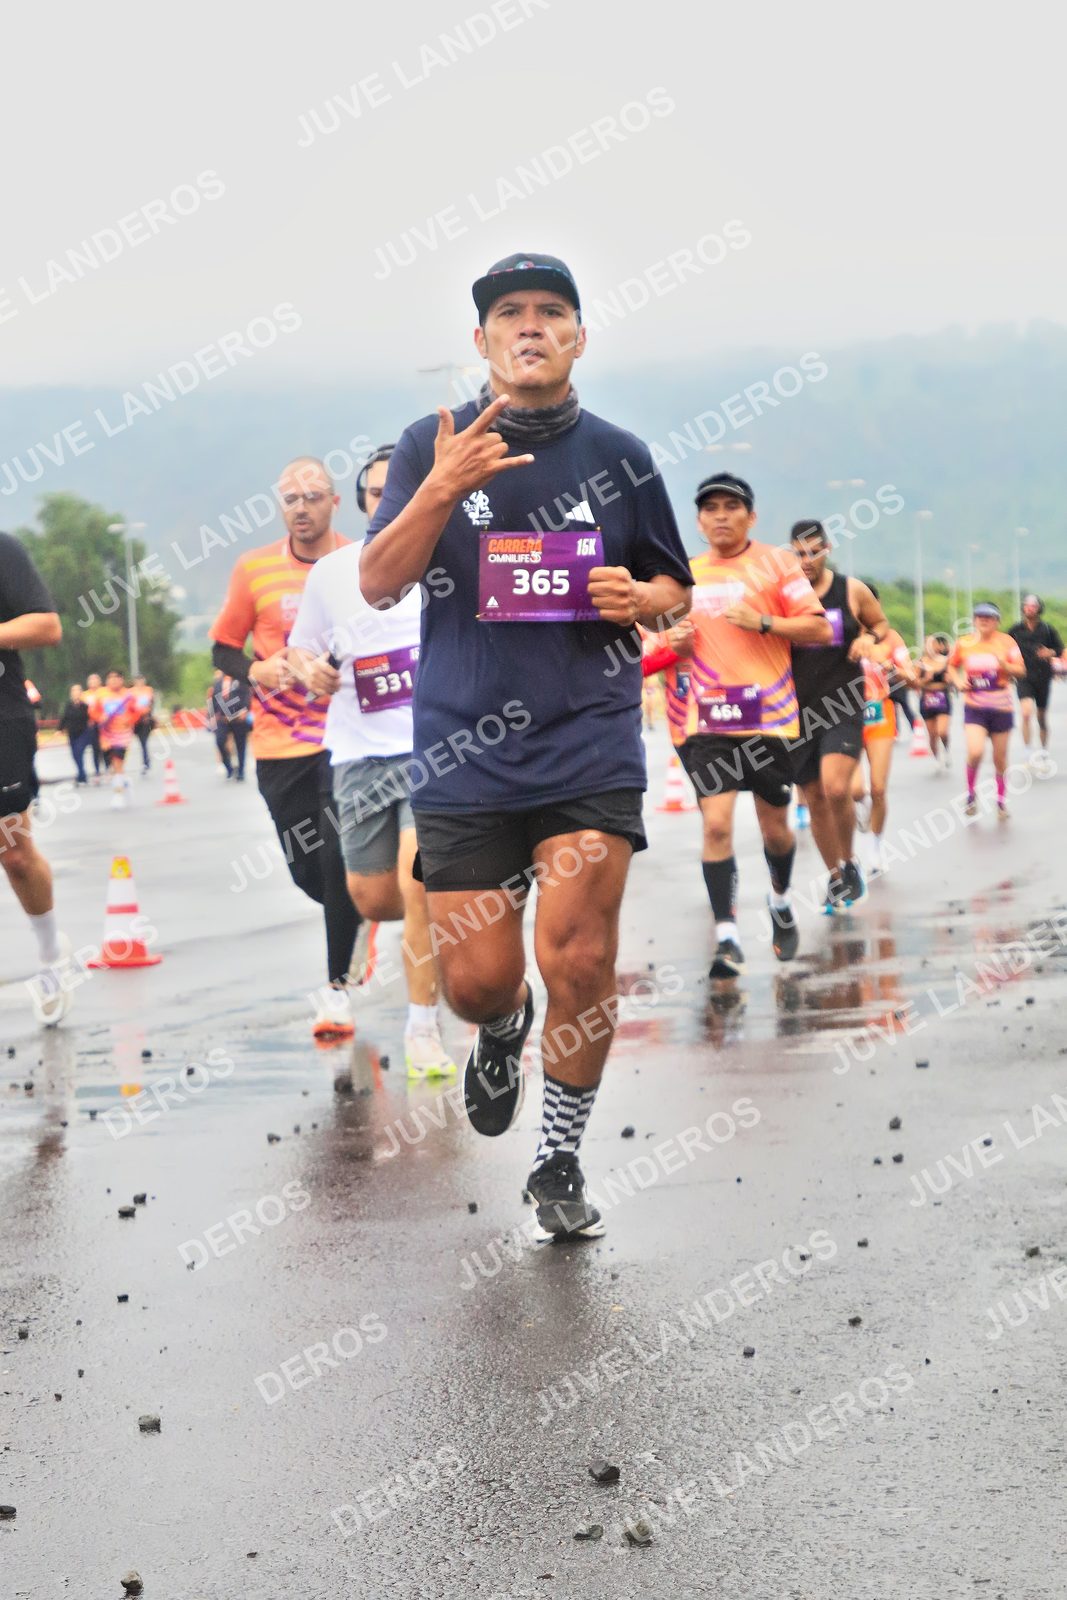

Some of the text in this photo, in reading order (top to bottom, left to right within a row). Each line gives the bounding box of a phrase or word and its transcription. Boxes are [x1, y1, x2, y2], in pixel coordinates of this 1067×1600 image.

[488, 538, 543, 553] CARRERA
[512, 569, 570, 595] 365
[374, 670, 413, 696] 331
[710, 704, 743, 721] 464
